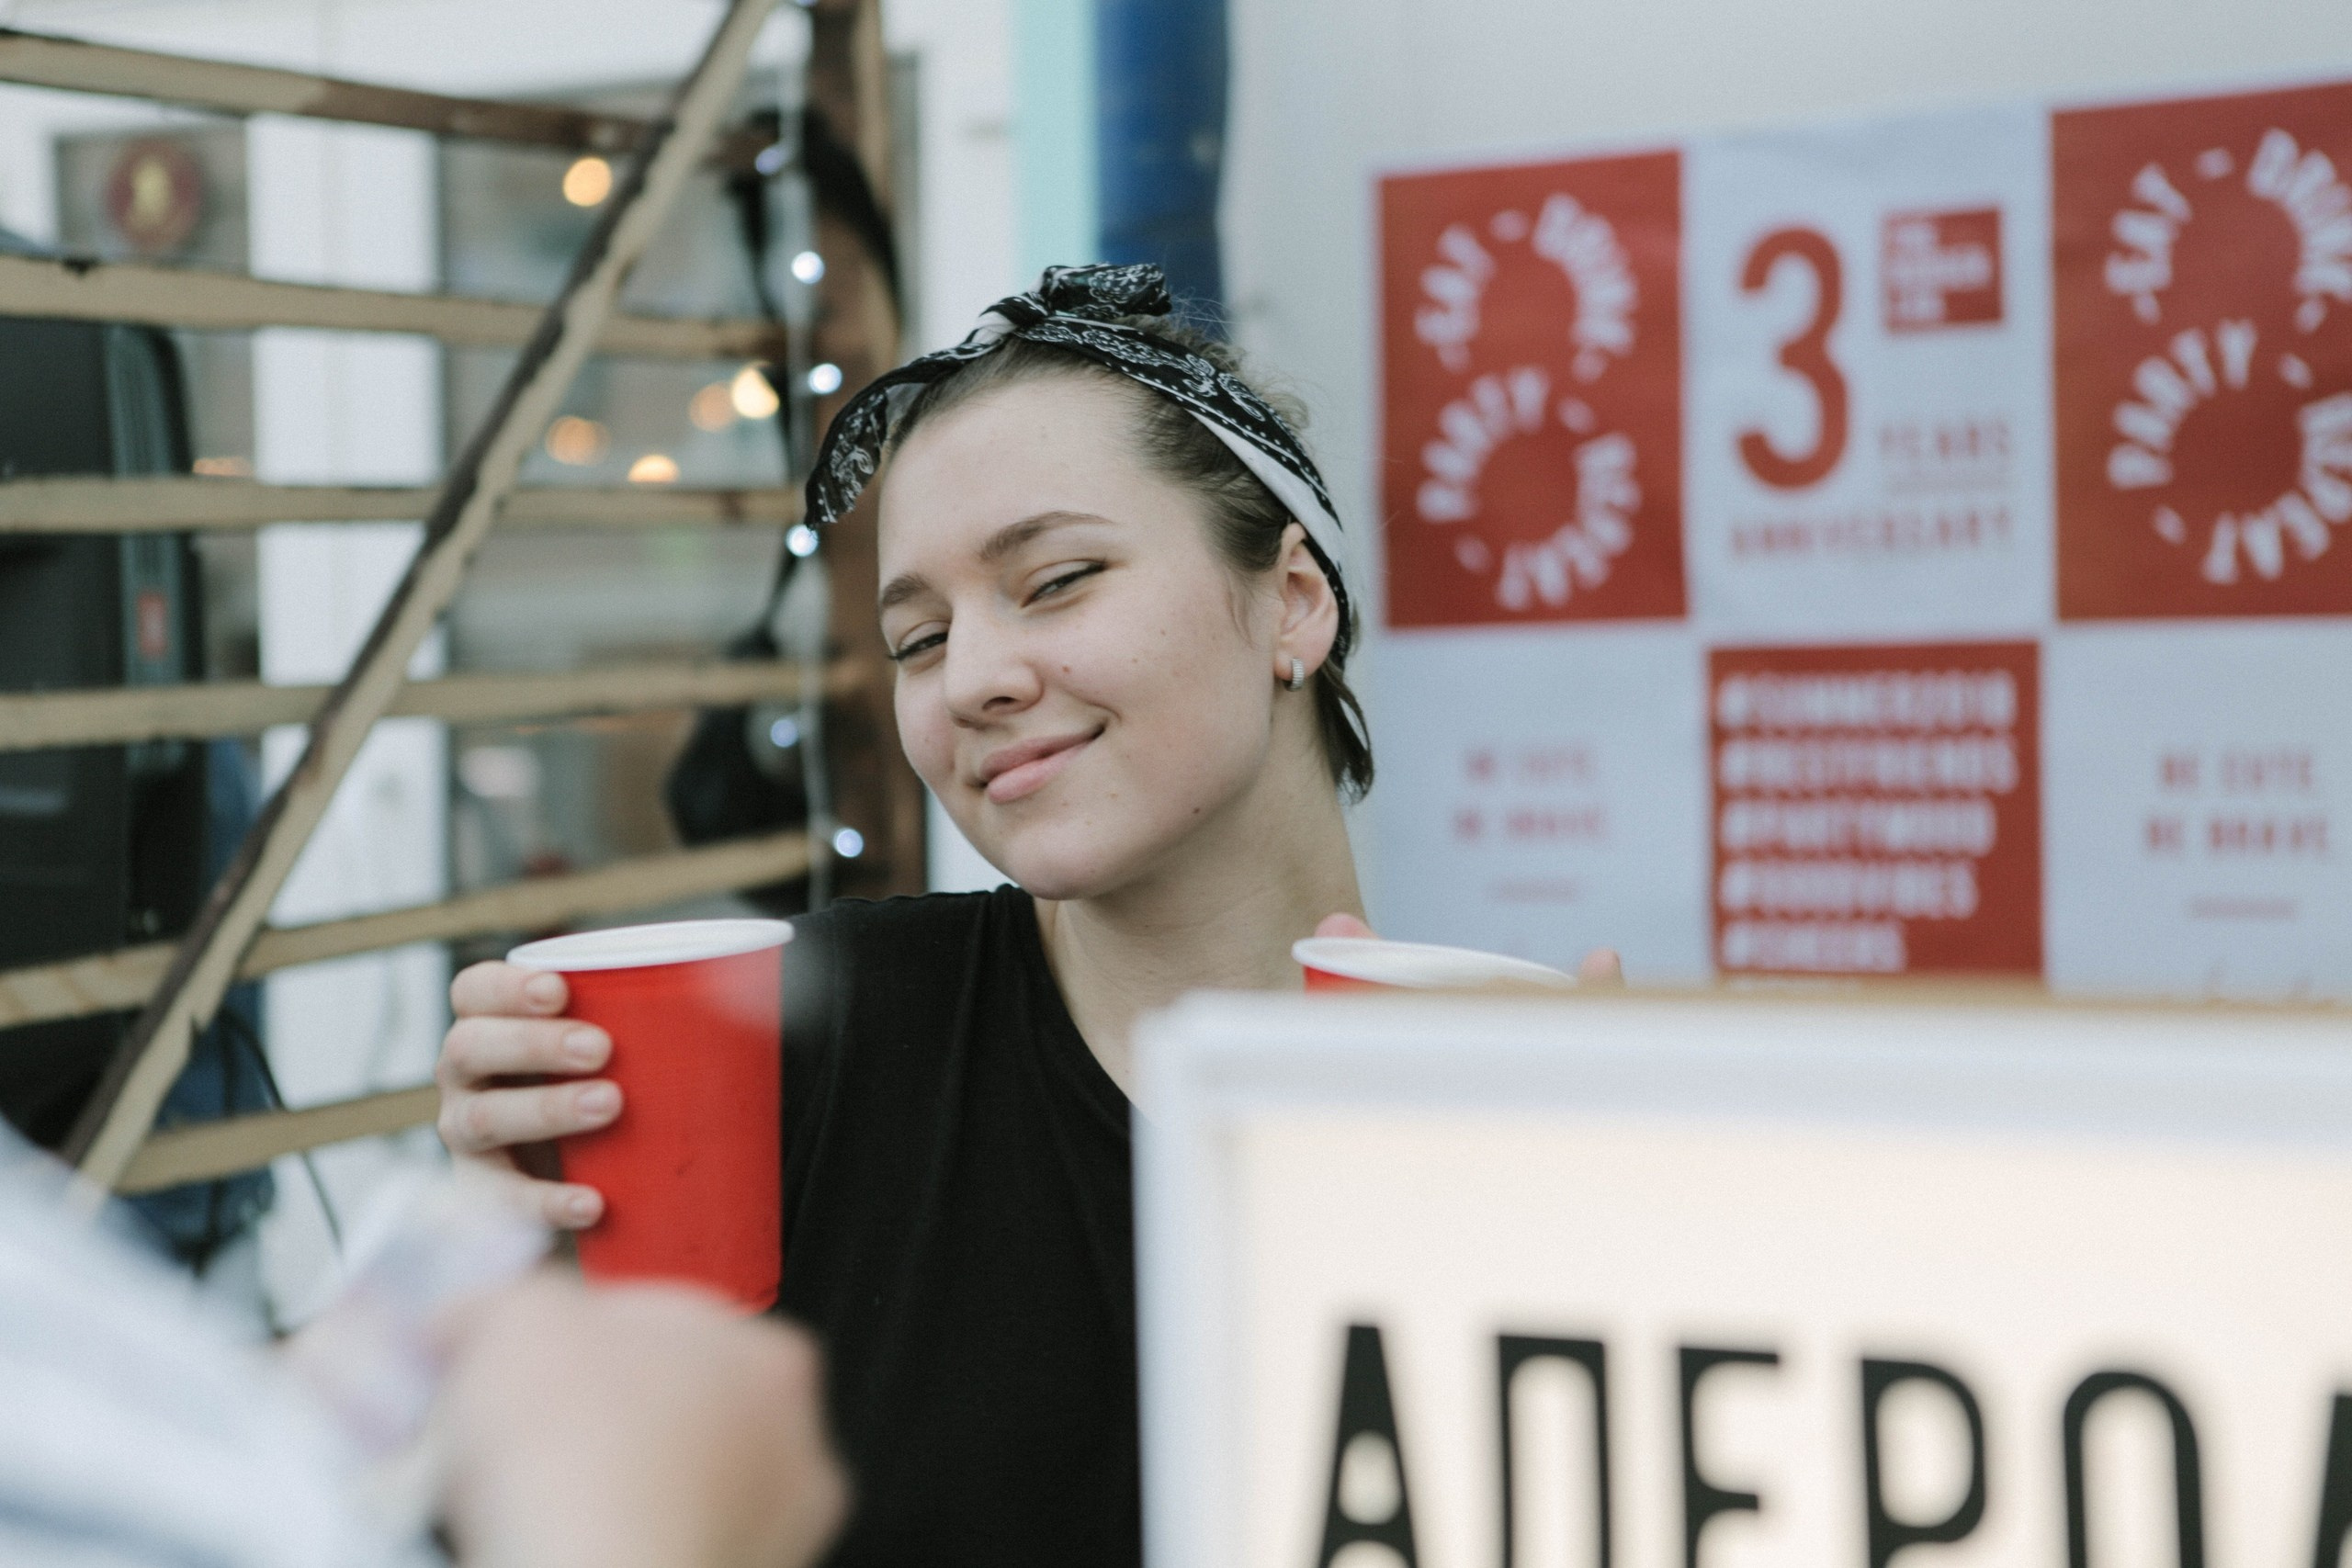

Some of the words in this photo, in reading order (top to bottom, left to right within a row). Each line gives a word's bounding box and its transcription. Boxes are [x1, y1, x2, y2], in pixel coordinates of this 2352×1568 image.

[1415, 224, 1496, 345] EAT
[1532, 193, 1638, 358] DRINK
[2106, 164, 2192, 294] EAT
[2247, 128, 2352, 305] DRINK
[1736, 225, 1850, 494] 3
[1879, 421, 2011, 461] YEARS
[1415, 366, 1551, 524] PARTY
[1494, 430, 1643, 611] REPEAT
[1732, 507, 2011, 558] ANNIVERSARY
[2108, 317, 2258, 489] PARTY
[2201, 390, 2352, 584] REPEAT
[2147, 816, 2183, 853] BE
[2208, 816, 2326, 854] BRAVE
[2159, 753, 2198, 792] BE
[2220, 750, 2313, 790] CUTE
[1317, 1325, 2352, 1568] АПЕРО
